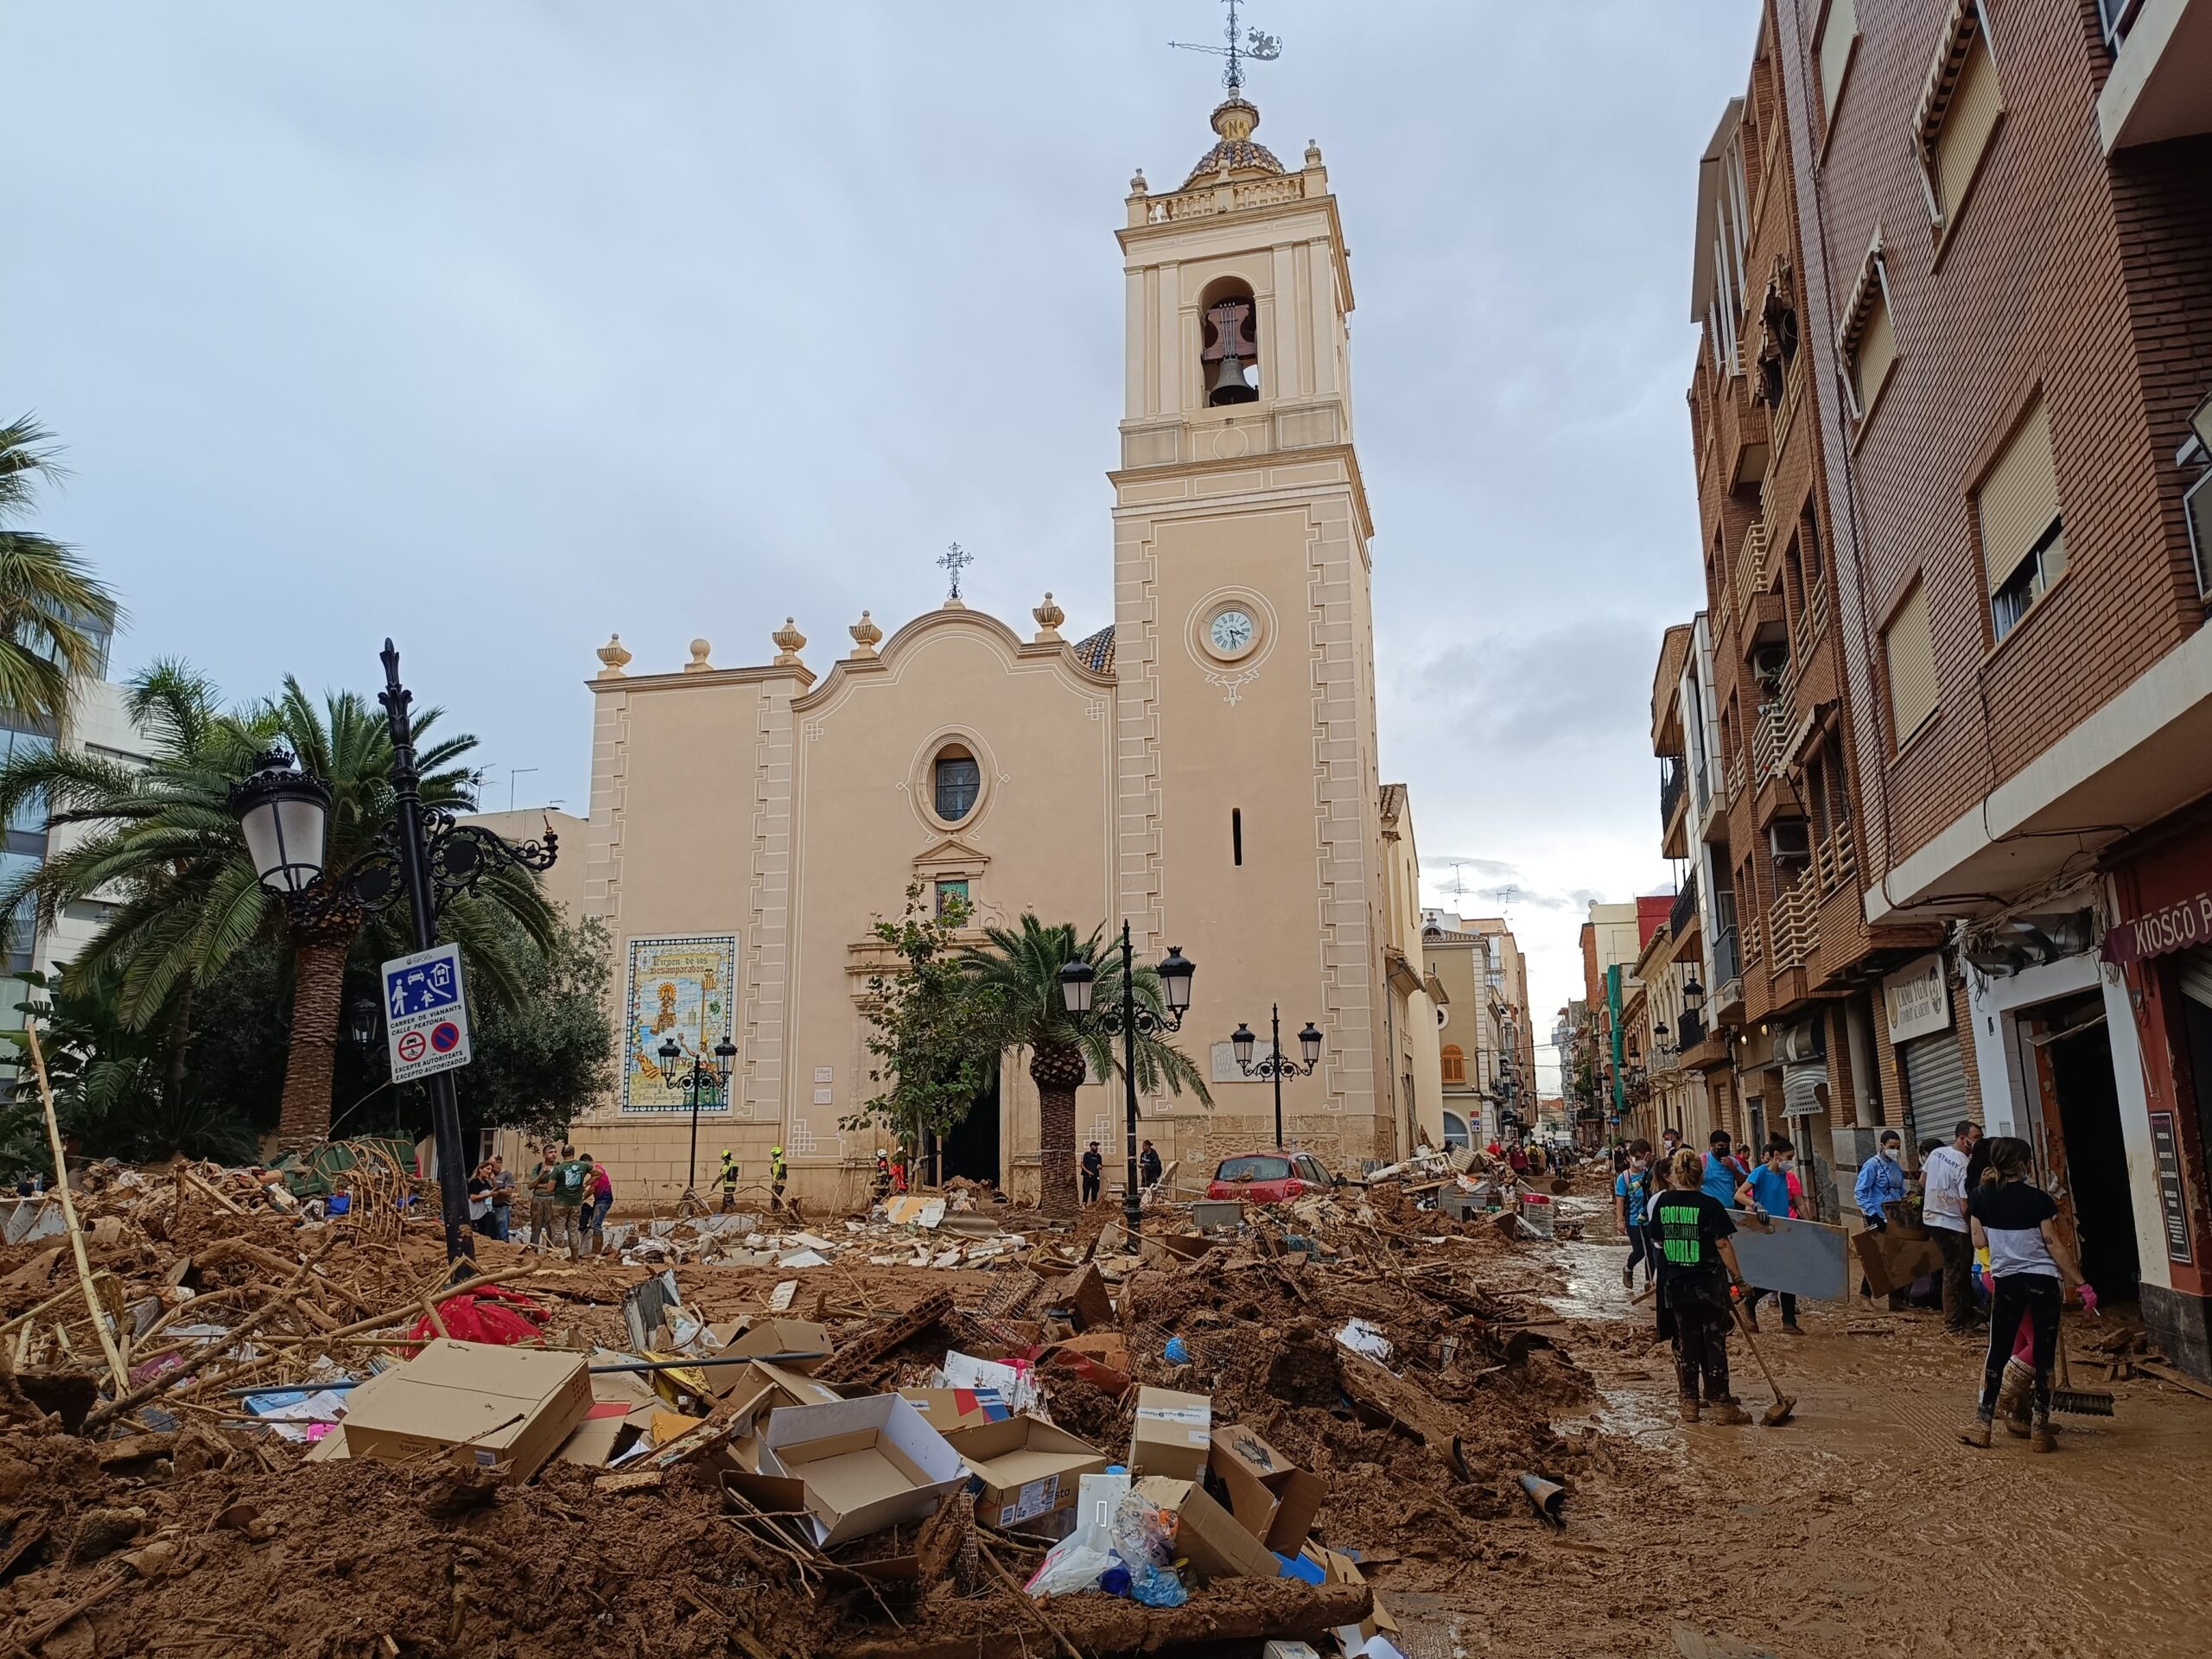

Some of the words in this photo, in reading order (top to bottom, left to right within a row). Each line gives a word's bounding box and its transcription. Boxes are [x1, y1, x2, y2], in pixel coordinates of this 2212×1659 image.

[2134, 906, 2196, 955] KIOSCO
[649, 965, 705, 976] Desamparados
[390, 1017, 416, 1028] CARRER
[430, 1004, 462, 1017] VIANANTS
[391, 1026, 411, 1036] CALLE
[414, 1016, 447, 1029] PEATONAL
[395, 1062, 422, 1074] EXCEPTE
[423, 1050, 463, 1065] AUTORITZATS
[396, 1069, 423, 1081] EXCEPTO
[424, 1057, 467, 1072] AUTORIZADOS
[1660, 1206, 1700, 1224] COOLWAY
[1663, 1239, 1700, 1262] WRLD
